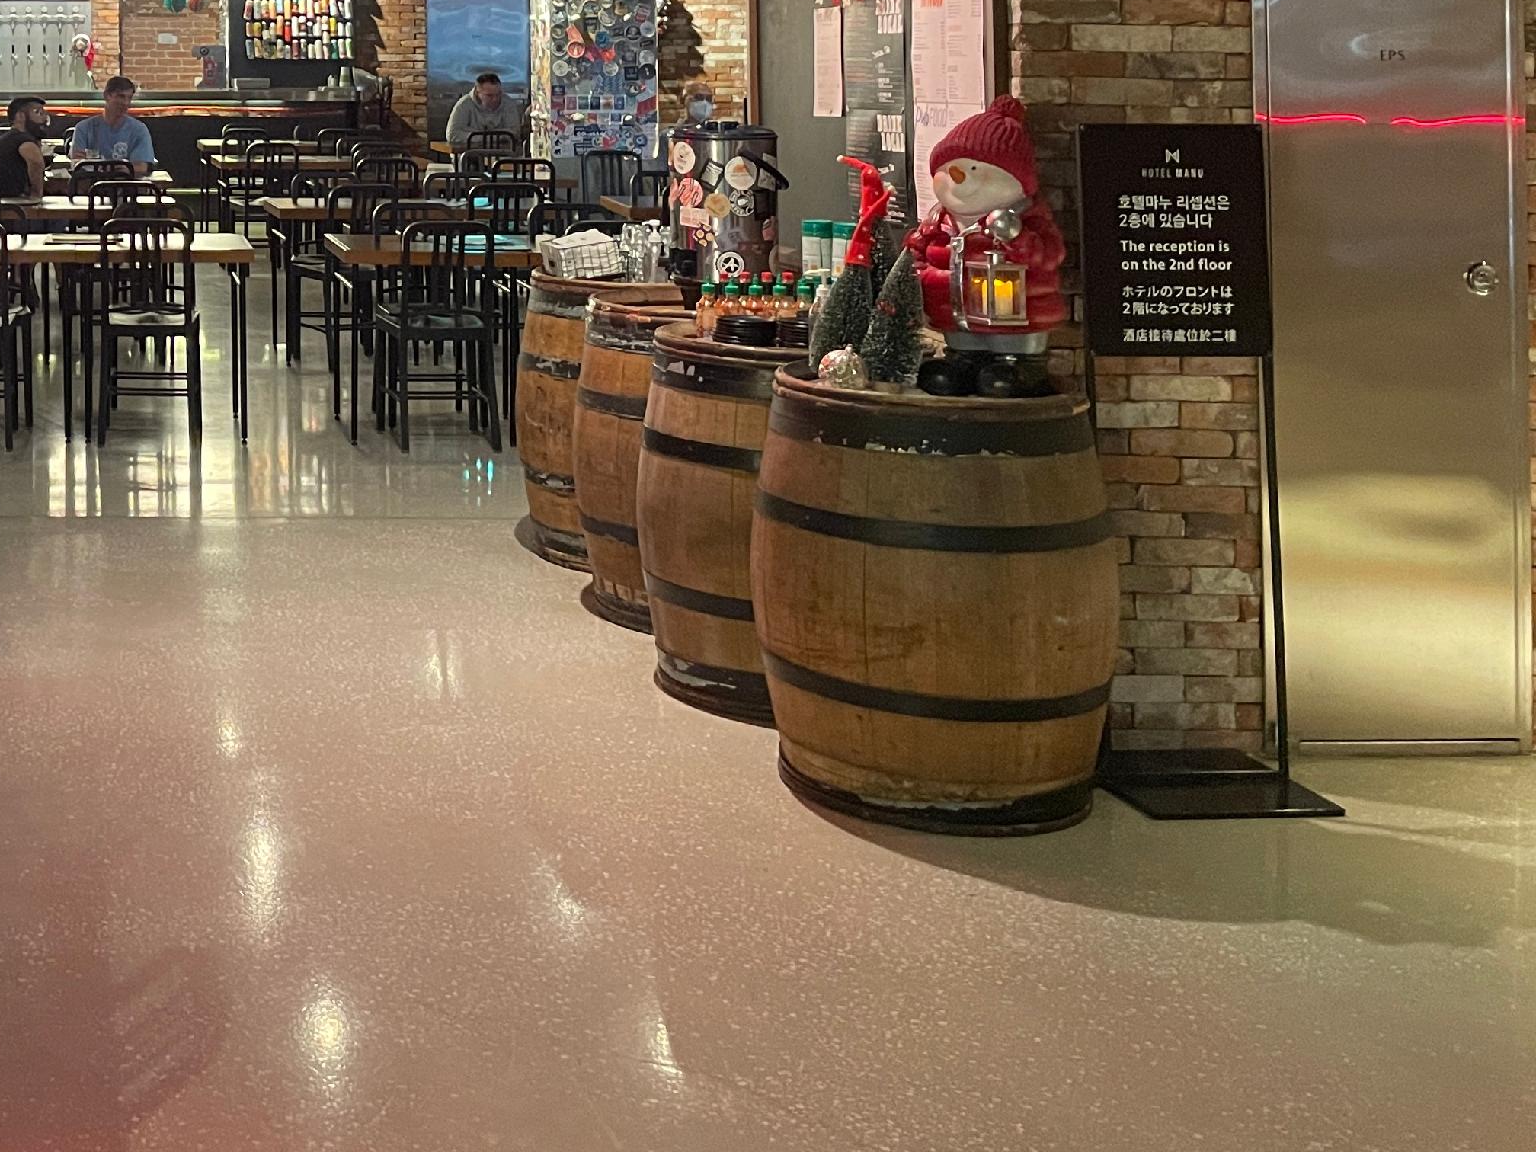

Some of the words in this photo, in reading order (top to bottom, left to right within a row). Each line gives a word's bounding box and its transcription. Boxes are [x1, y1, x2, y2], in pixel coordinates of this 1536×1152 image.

[1380, 49, 1406, 61] EPS
[1141, 167, 1172, 179] HOTEL
[1175, 167, 1204, 179] MANU
[1117, 194, 1173, 211] 호텔마누
[1176, 194, 1230, 211] 리셉션은
[1118, 213, 1155, 229] 2층에
[1159, 213, 1213, 229] 있습니다
[1120, 240, 1146, 252] The
[1149, 240, 1215, 255] reception
[1218, 240, 1230, 252] is
[1121, 260, 1139, 271] on
[1142, 258, 1166, 271] the
[1169, 258, 1194, 271] 2nd
[1198, 258, 1233, 271] floor
[1122, 285, 1233, 298] ホテルのフロントは
